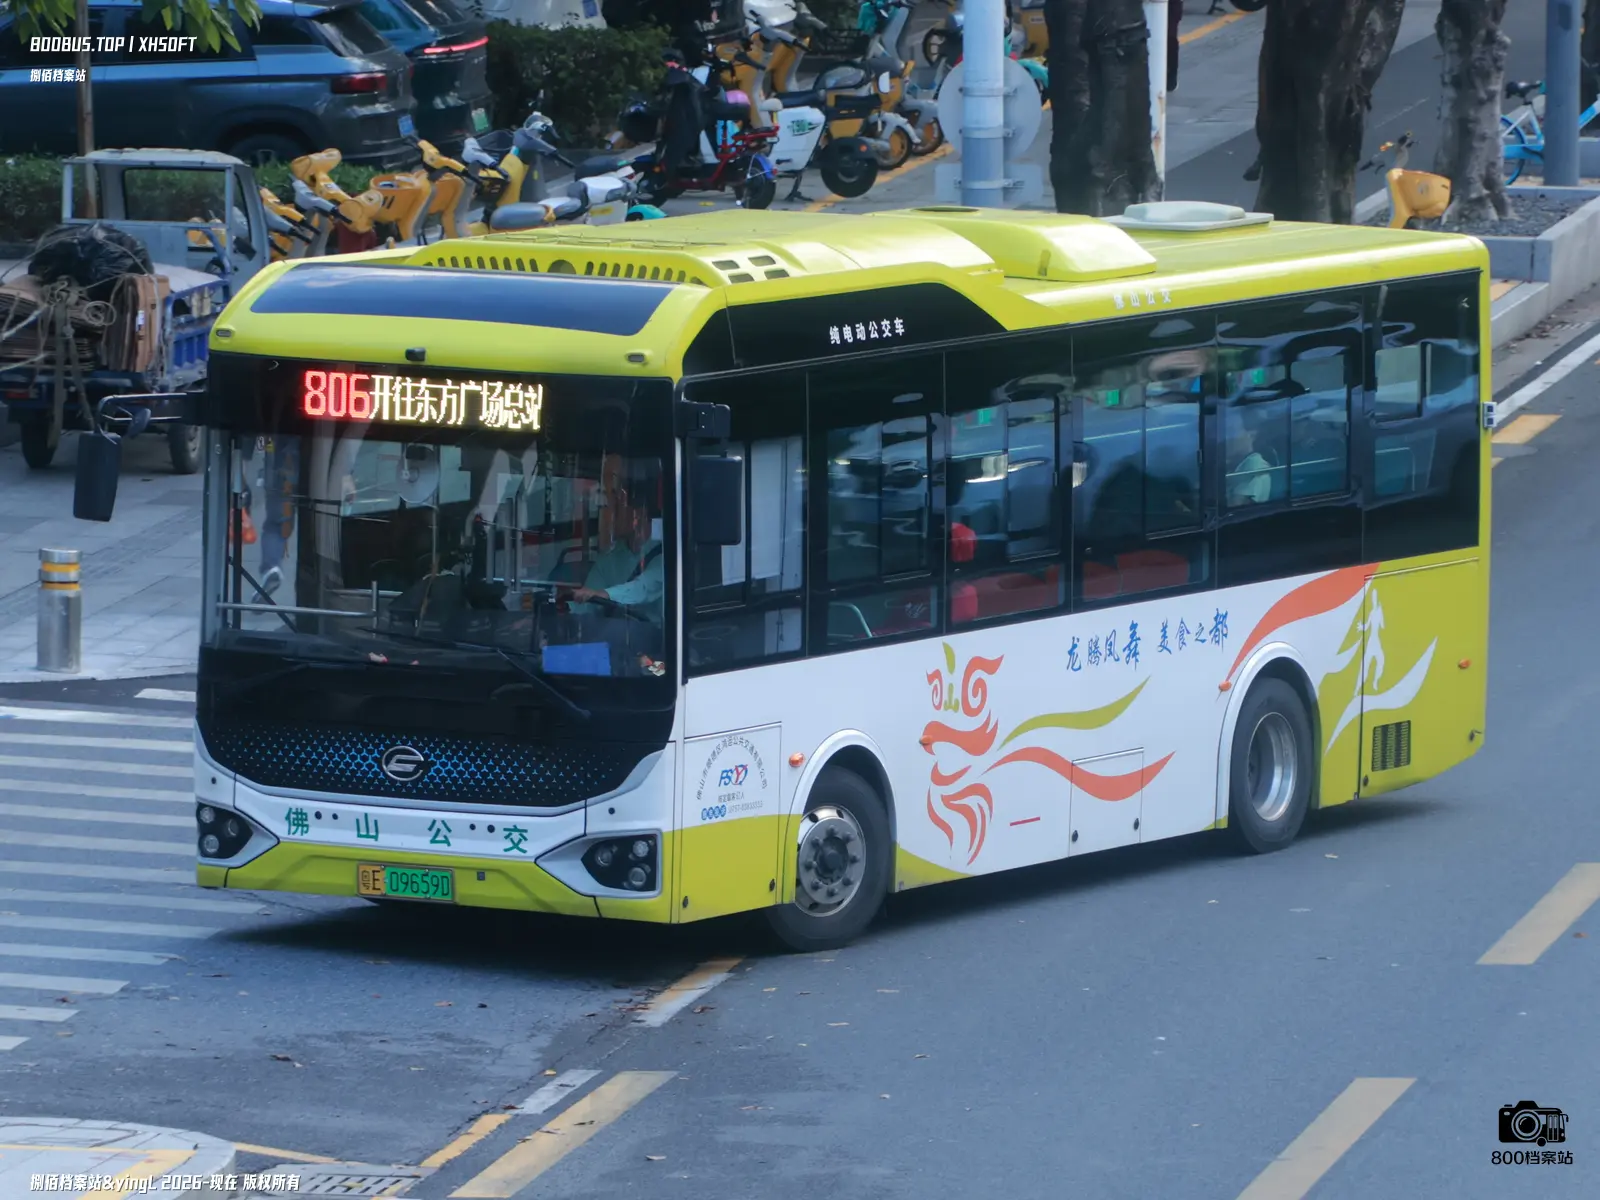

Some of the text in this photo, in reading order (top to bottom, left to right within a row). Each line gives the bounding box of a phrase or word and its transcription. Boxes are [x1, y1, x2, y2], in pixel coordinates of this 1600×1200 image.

[829, 316, 905, 345] 纯电动公交车
[303, 370, 370, 419] 806
[1066, 607, 1229, 671] 龙腾凤舞 美食之都
[284, 807, 528, 854] 佛山公交
